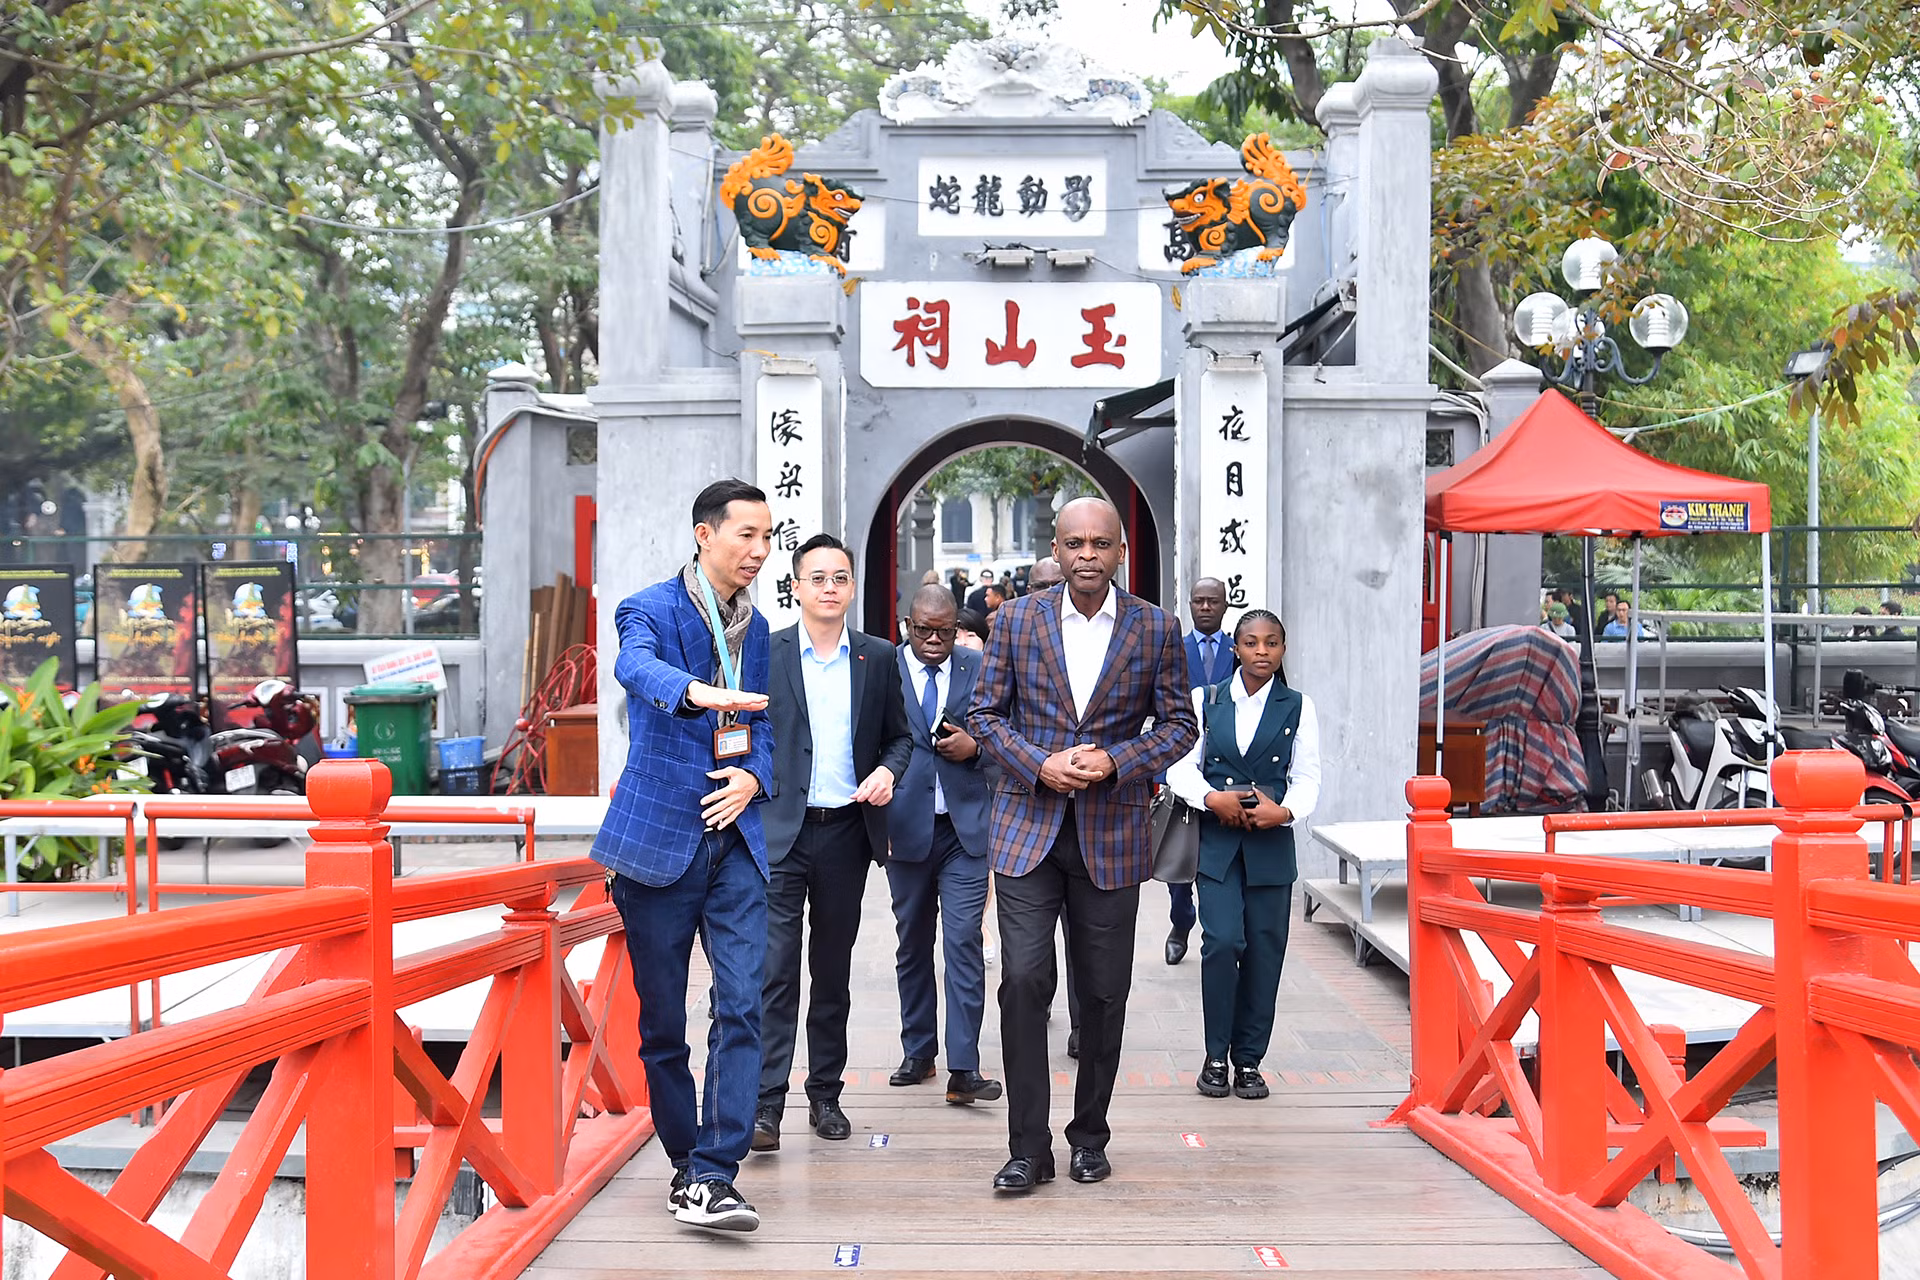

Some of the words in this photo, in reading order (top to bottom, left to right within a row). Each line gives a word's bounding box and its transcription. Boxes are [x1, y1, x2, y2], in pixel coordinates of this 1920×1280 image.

[1219, 404, 1251, 637] 夜月或過
[1687, 503, 1707, 516] KIM
